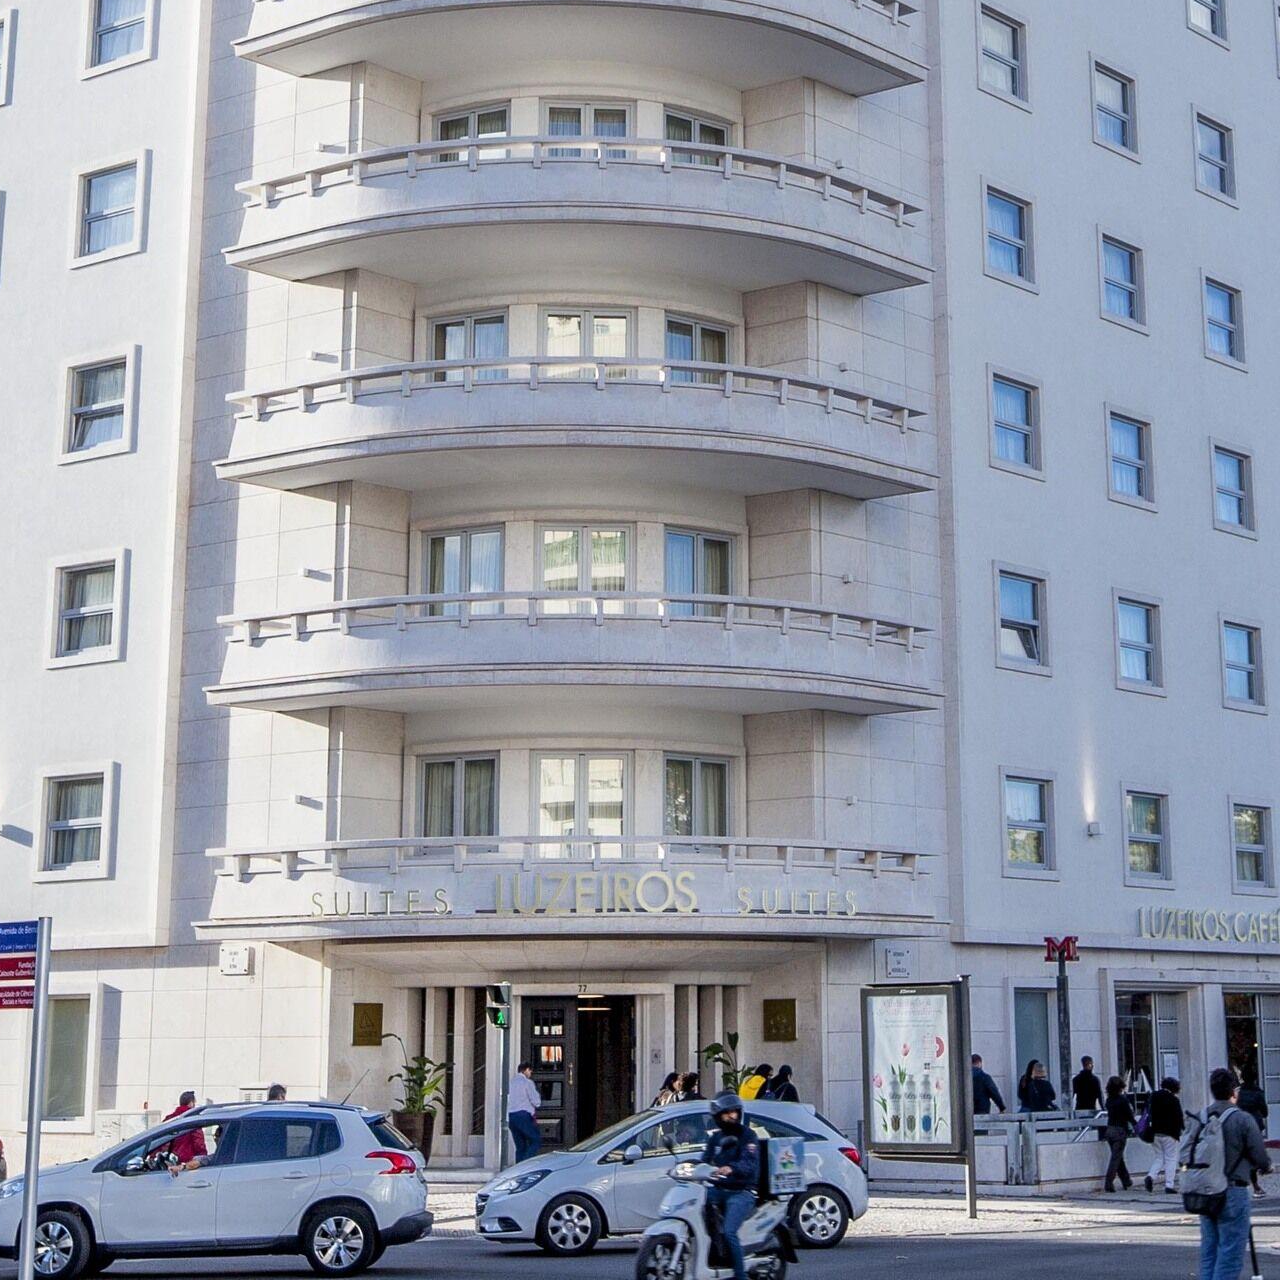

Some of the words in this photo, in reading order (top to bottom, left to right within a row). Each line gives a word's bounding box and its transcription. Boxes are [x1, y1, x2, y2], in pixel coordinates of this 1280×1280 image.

[311, 888, 451, 917] SUITES
[495, 870, 699, 915] LUZEIROS
[737, 886, 858, 917] SUITES
[1138, 906, 1230, 941] LUZEIROS
[1044, 936, 1079, 961] M
[578, 984, 587, 992] 77
